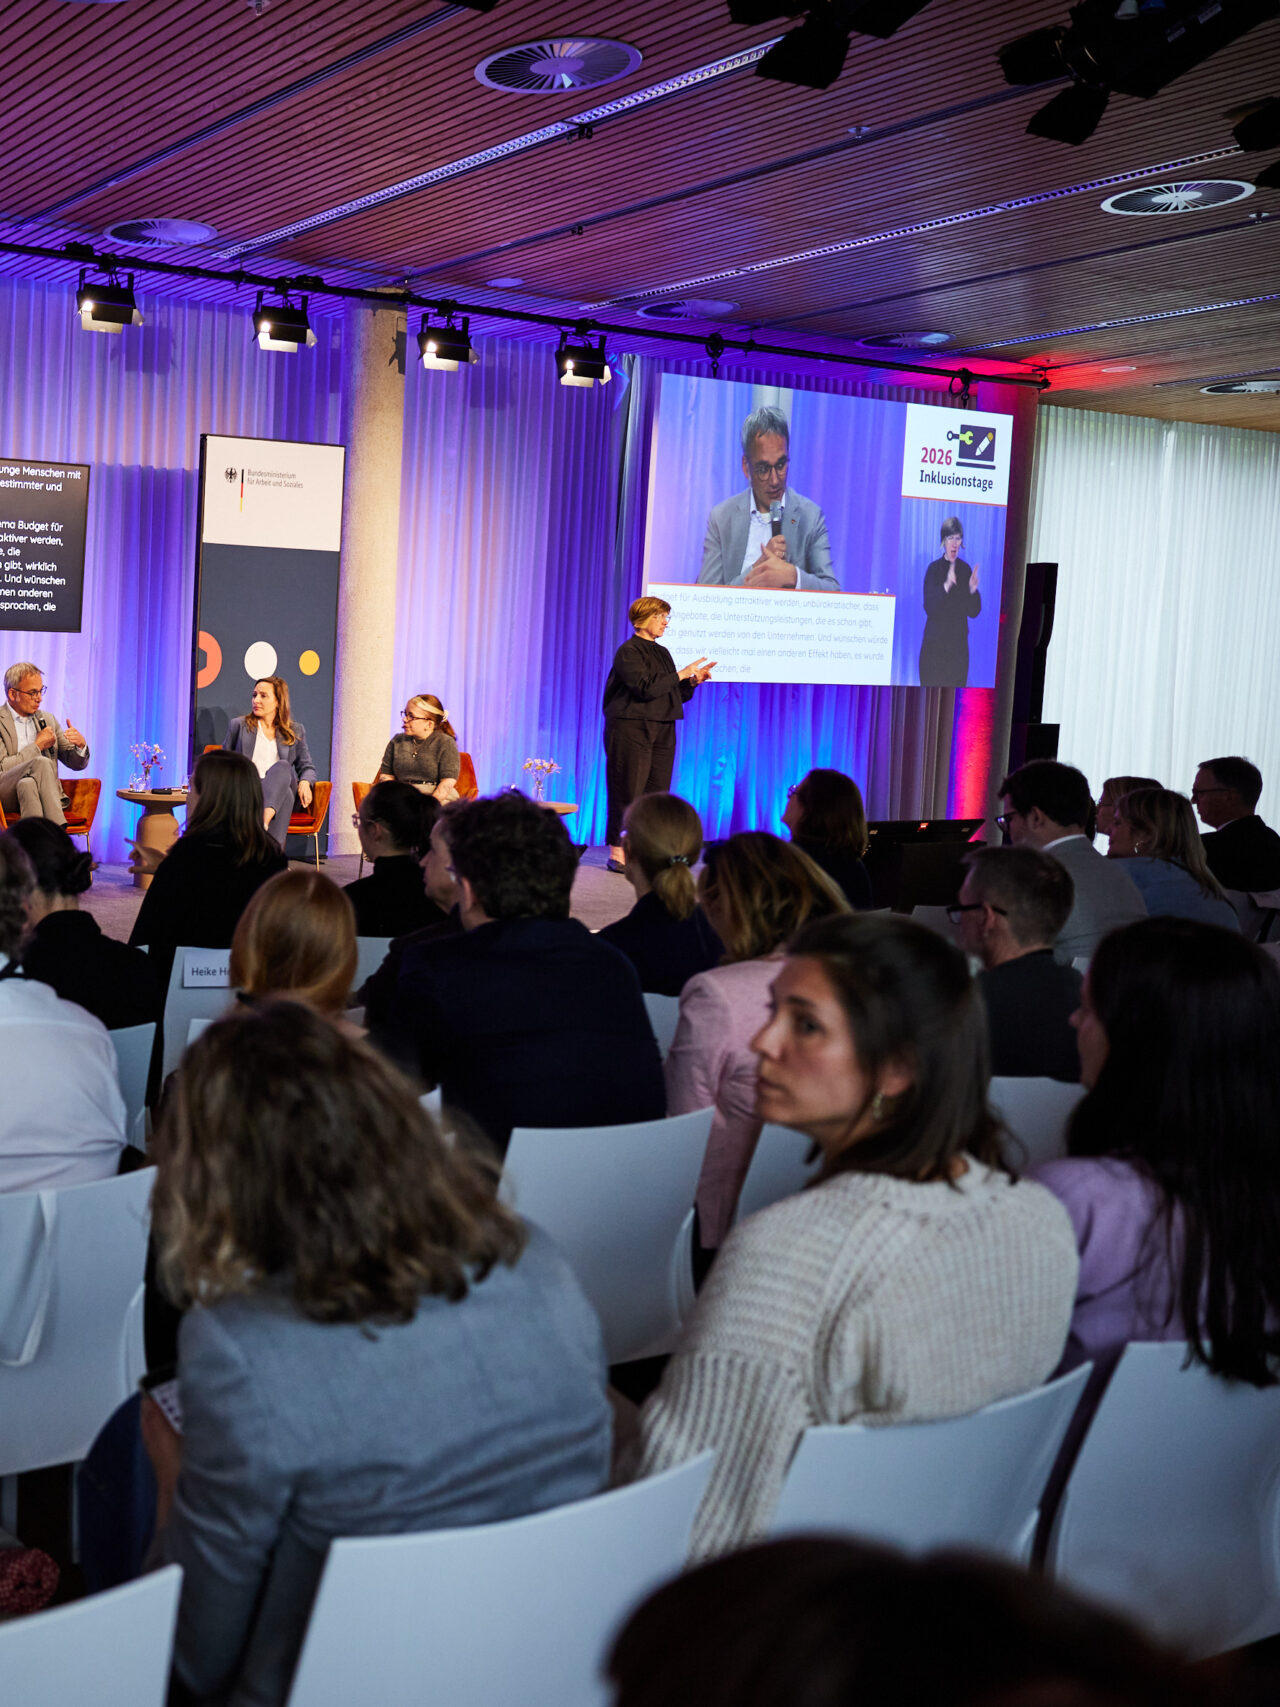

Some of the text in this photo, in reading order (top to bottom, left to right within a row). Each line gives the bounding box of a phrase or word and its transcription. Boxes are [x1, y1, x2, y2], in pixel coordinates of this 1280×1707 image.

[921, 447, 952, 466] 2026
[22, 466, 65, 478] Menschen
[67, 470, 81, 479] mit
[248, 469, 296, 479] Bundesministerium
[920, 470, 993, 492] Inklusionstage
[45, 482, 62, 491] und
[17, 520, 48, 532] Budget
[50, 522, 63, 531] für
[7, 546, 20, 556] die
[25, 561, 57, 571] wirklich
[4, 574, 22, 583] Und
[24, 575, 65, 585] wünschen
[17, 588, 53, 597] anderen
[42, 602, 56, 611] die
[192, 967, 216, 976] Heike
